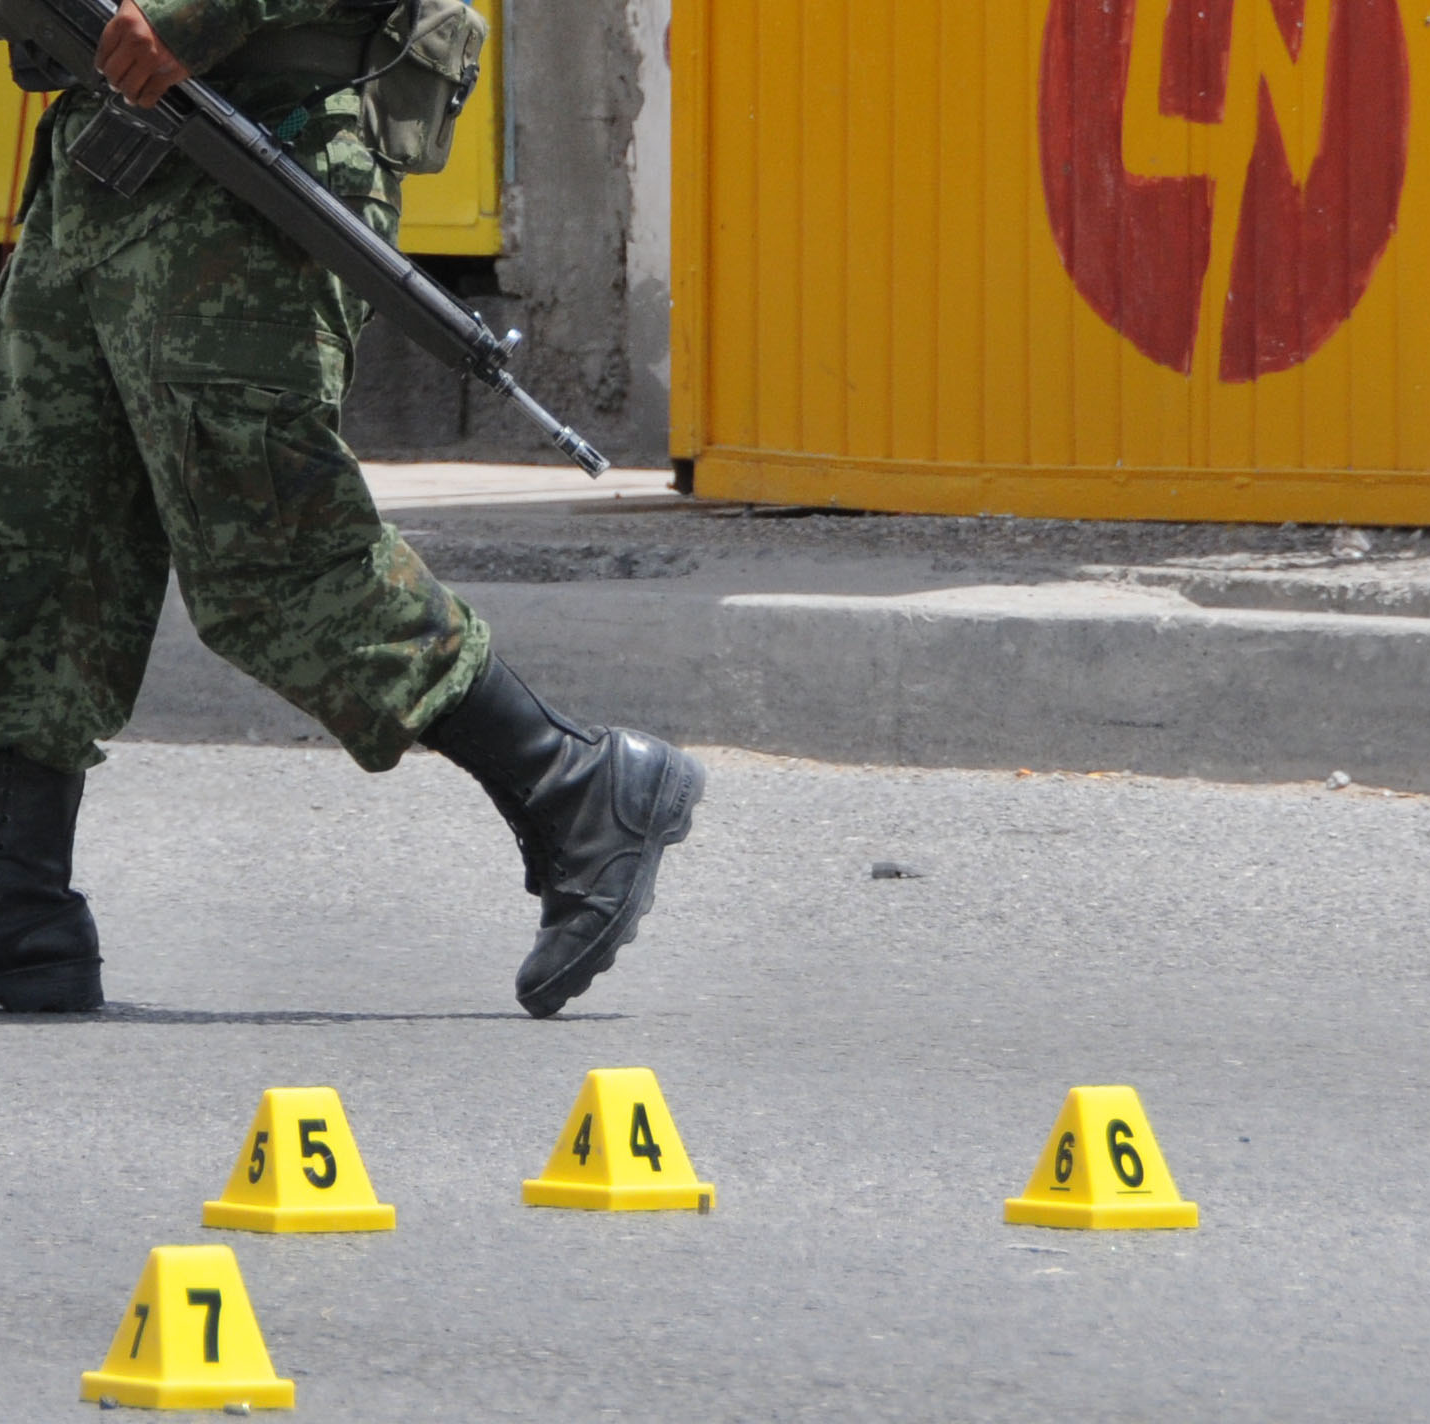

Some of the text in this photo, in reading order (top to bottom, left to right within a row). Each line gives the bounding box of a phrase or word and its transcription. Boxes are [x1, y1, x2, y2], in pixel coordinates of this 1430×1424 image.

[247, 1131, 269, 1185] 5
[297, 1118, 338, 1190] 5
[572, 1112, 593, 1166] 4
[629, 1102, 662, 1172] 4
[1053, 1130, 1075, 1184] 6
[1106, 1118, 1145, 1189] 6
[129, 1303, 150, 1360] 7
[185, 1287, 223, 1364] 7
